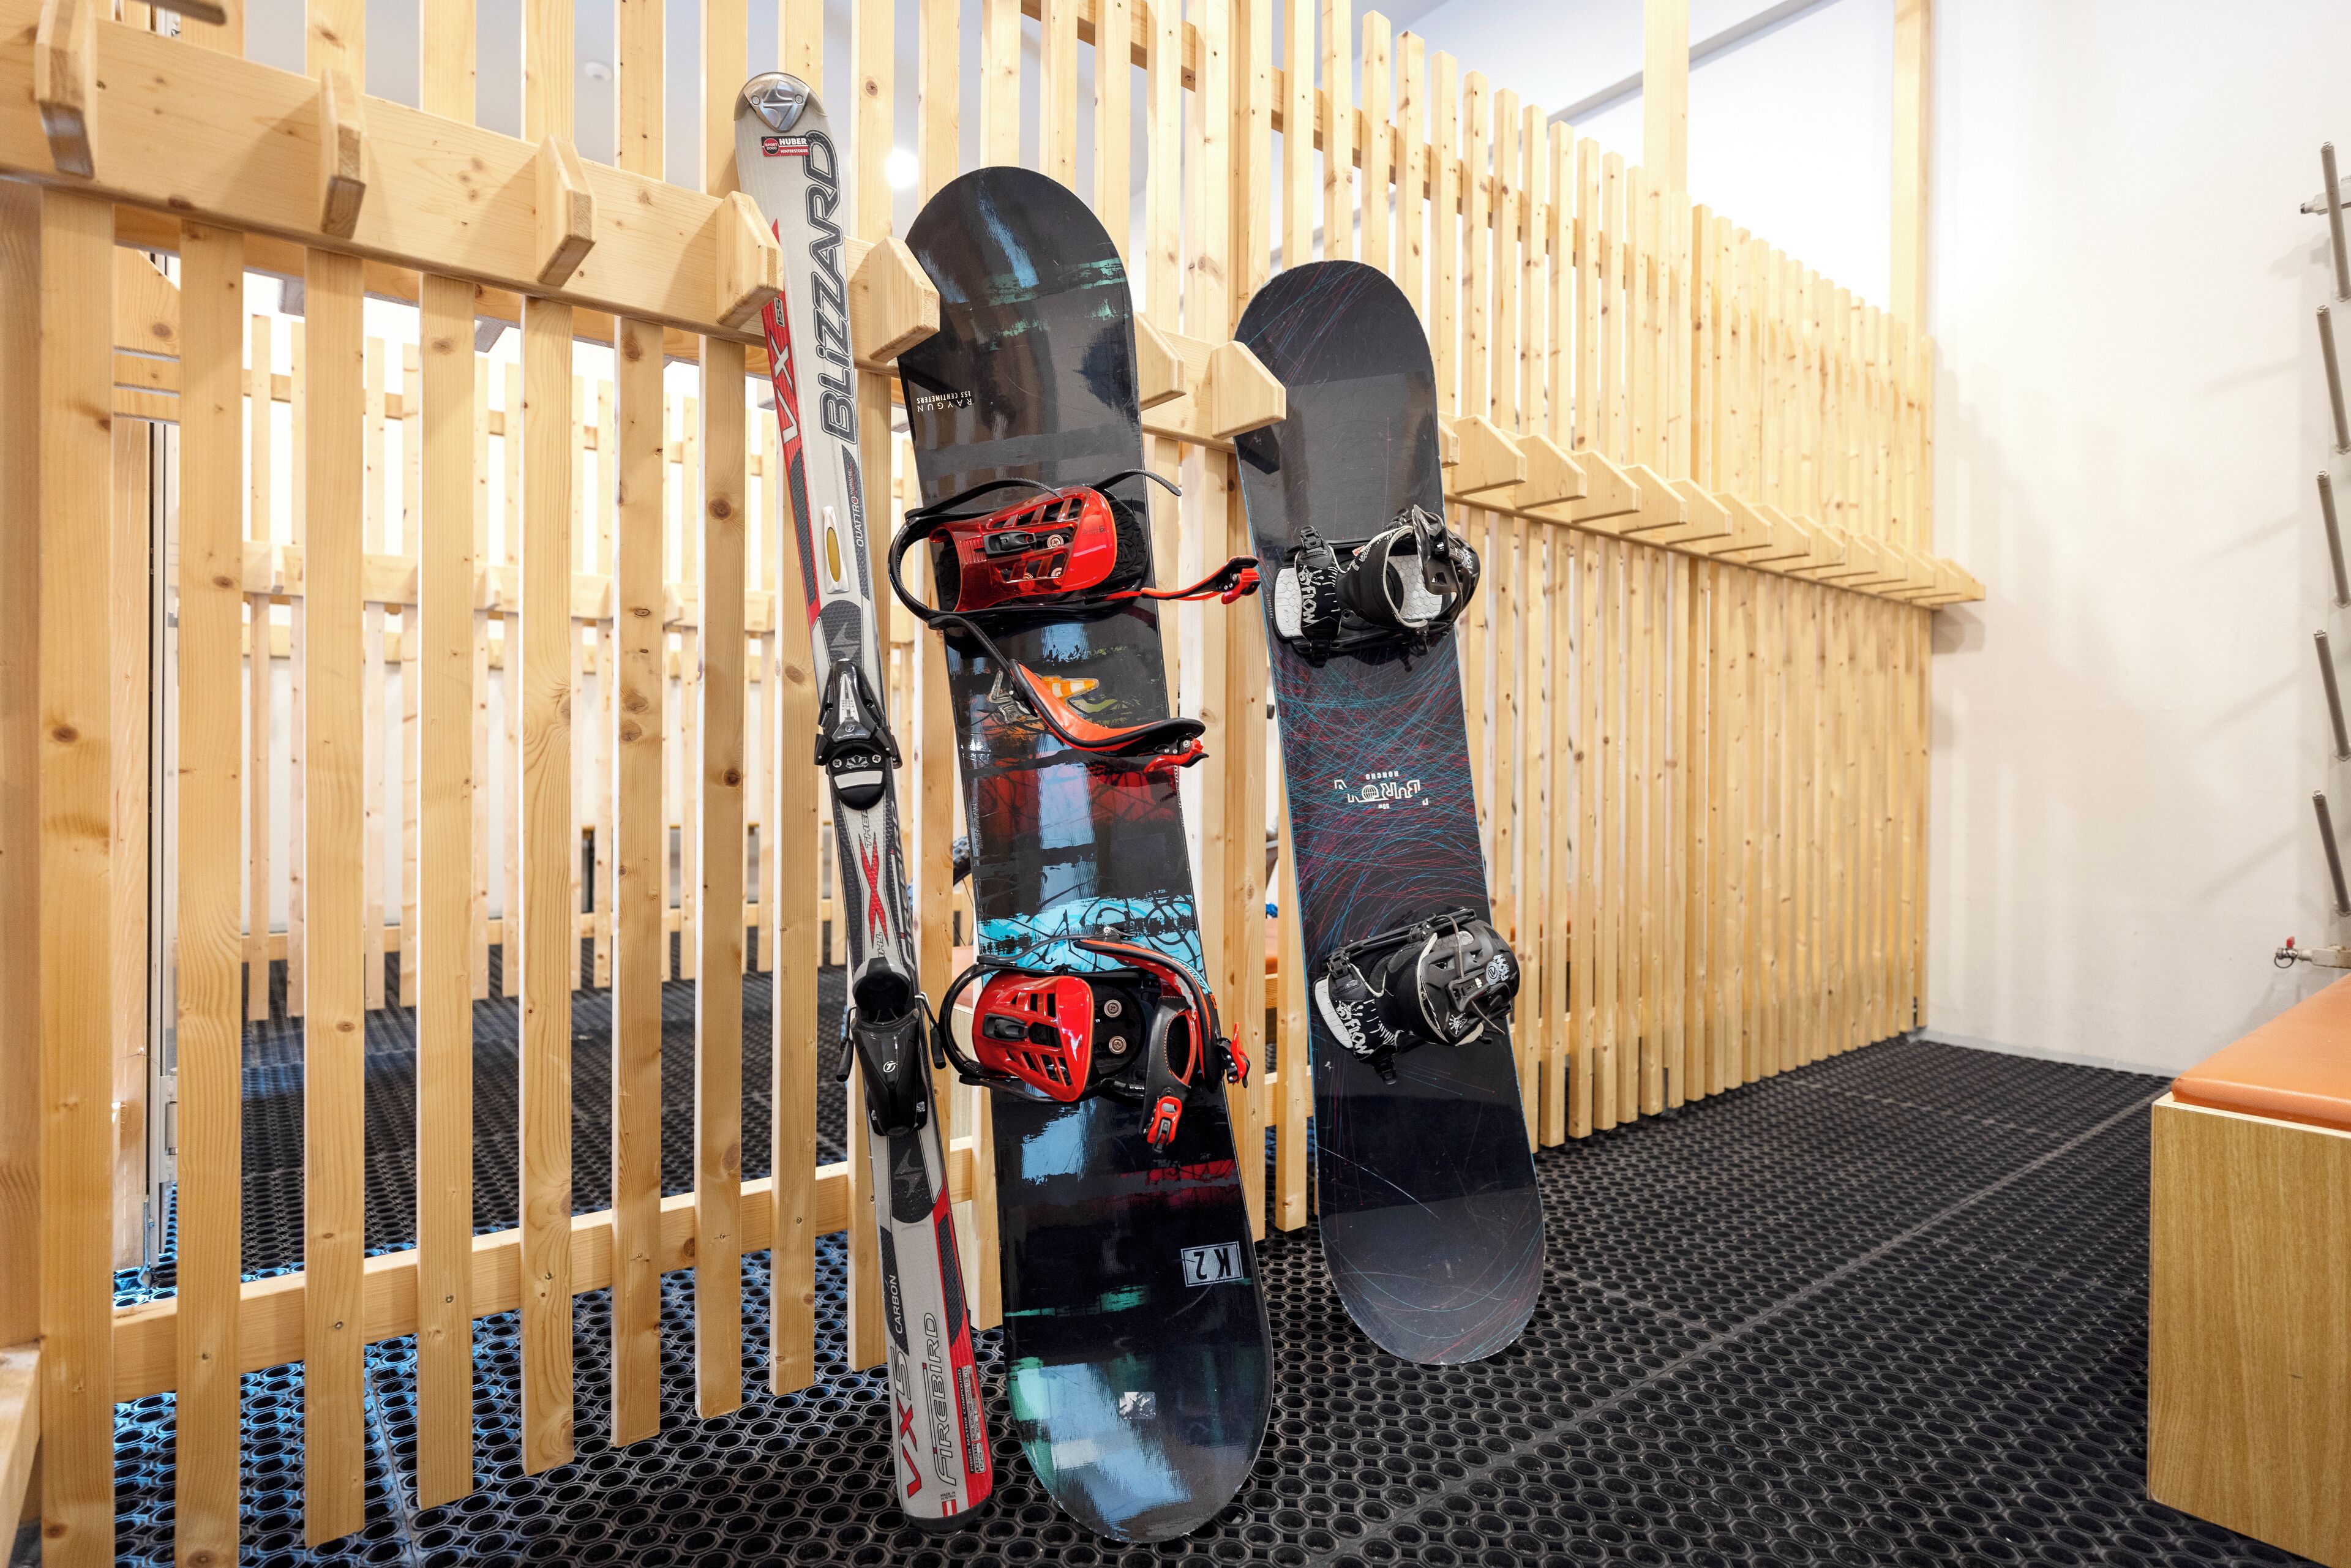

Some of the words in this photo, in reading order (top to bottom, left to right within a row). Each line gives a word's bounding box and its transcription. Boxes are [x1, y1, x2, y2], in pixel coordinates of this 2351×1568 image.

[774, 298, 784, 326] 155
[768, 329, 798, 444] VX
[917, 392, 958, 404] CENTIMETERS
[917, 398, 972, 413] RAYGUN
[852, 496, 864, 547] QUATTRO
[1301, 585, 1321, 625] FLOW
[1347, 779, 1421, 803] BURTON
[1365, 770, 1399, 780] HONCHO
[1345, 1018, 1374, 1054] FLOW
[1193, 1248, 1232, 1280] K2
[889, 1274, 903, 1335] CARBON
[957, 1369, 967, 1414] COMPOUND
